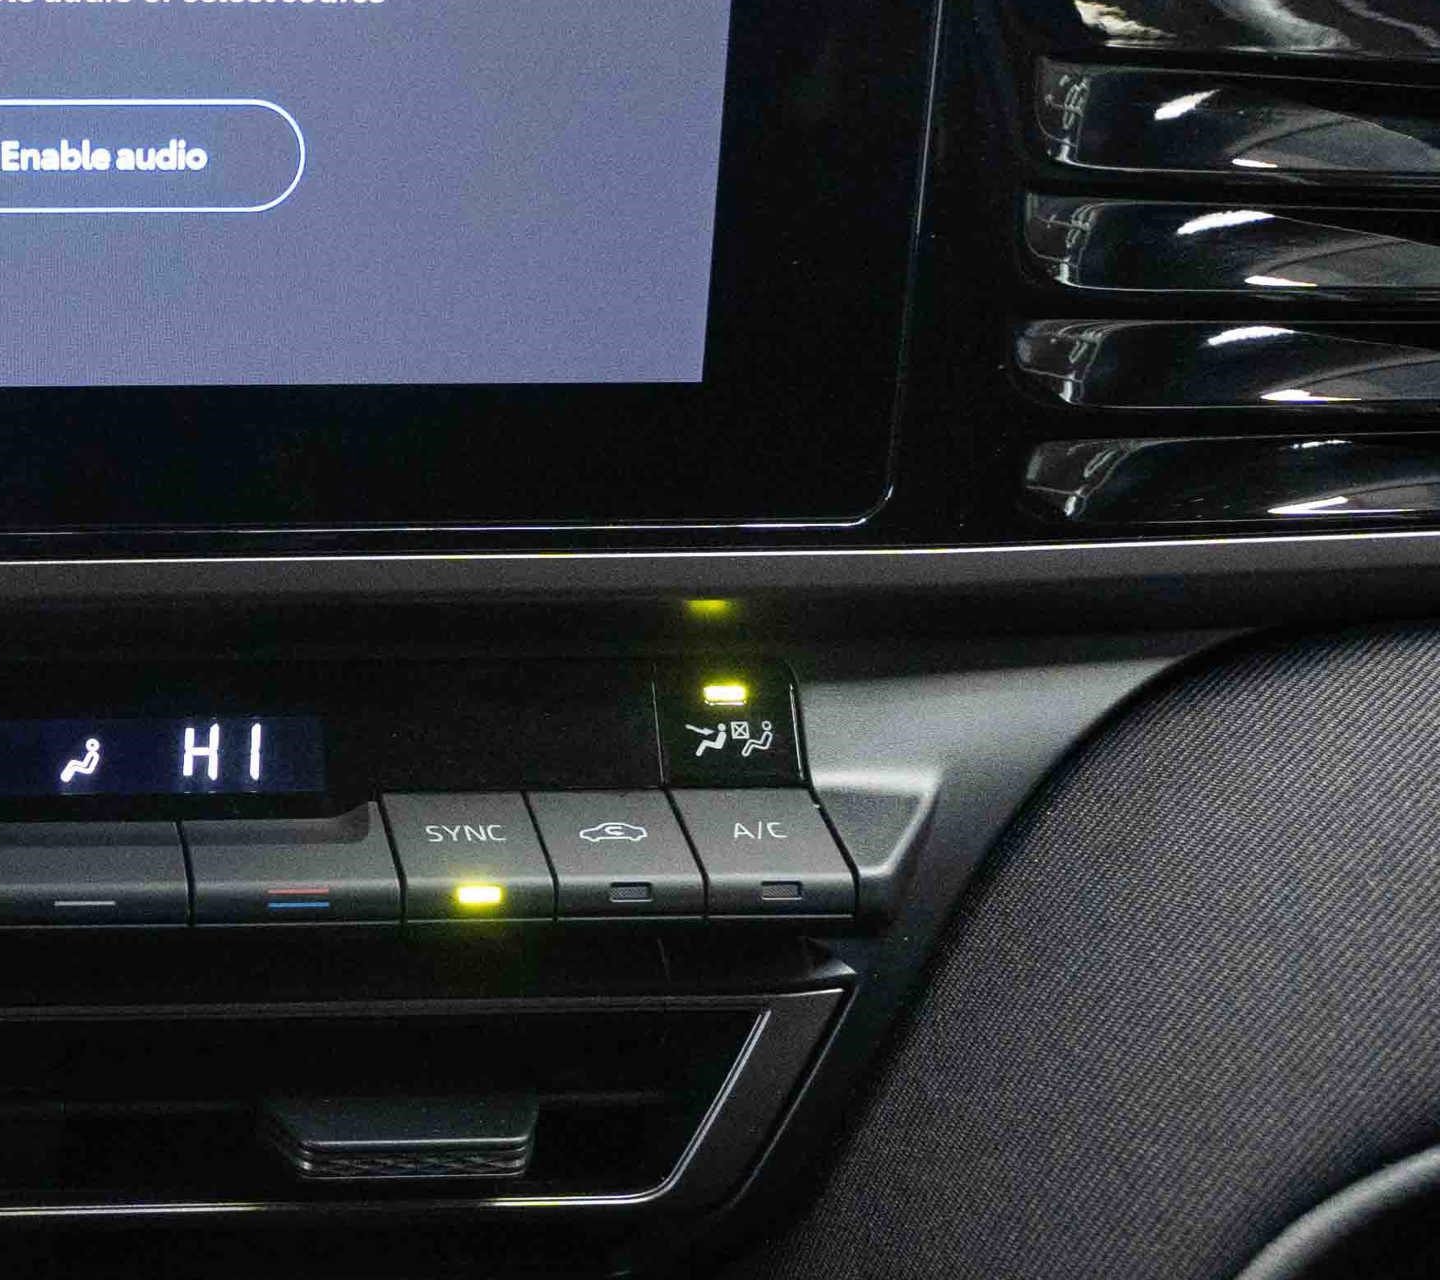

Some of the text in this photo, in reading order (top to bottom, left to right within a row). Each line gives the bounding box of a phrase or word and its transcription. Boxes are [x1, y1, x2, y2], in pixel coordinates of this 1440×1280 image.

[1, 138, 209, 171] Enable audio
[425, 824, 508, 843] SYNC
[733, 822, 787, 840] A/C
